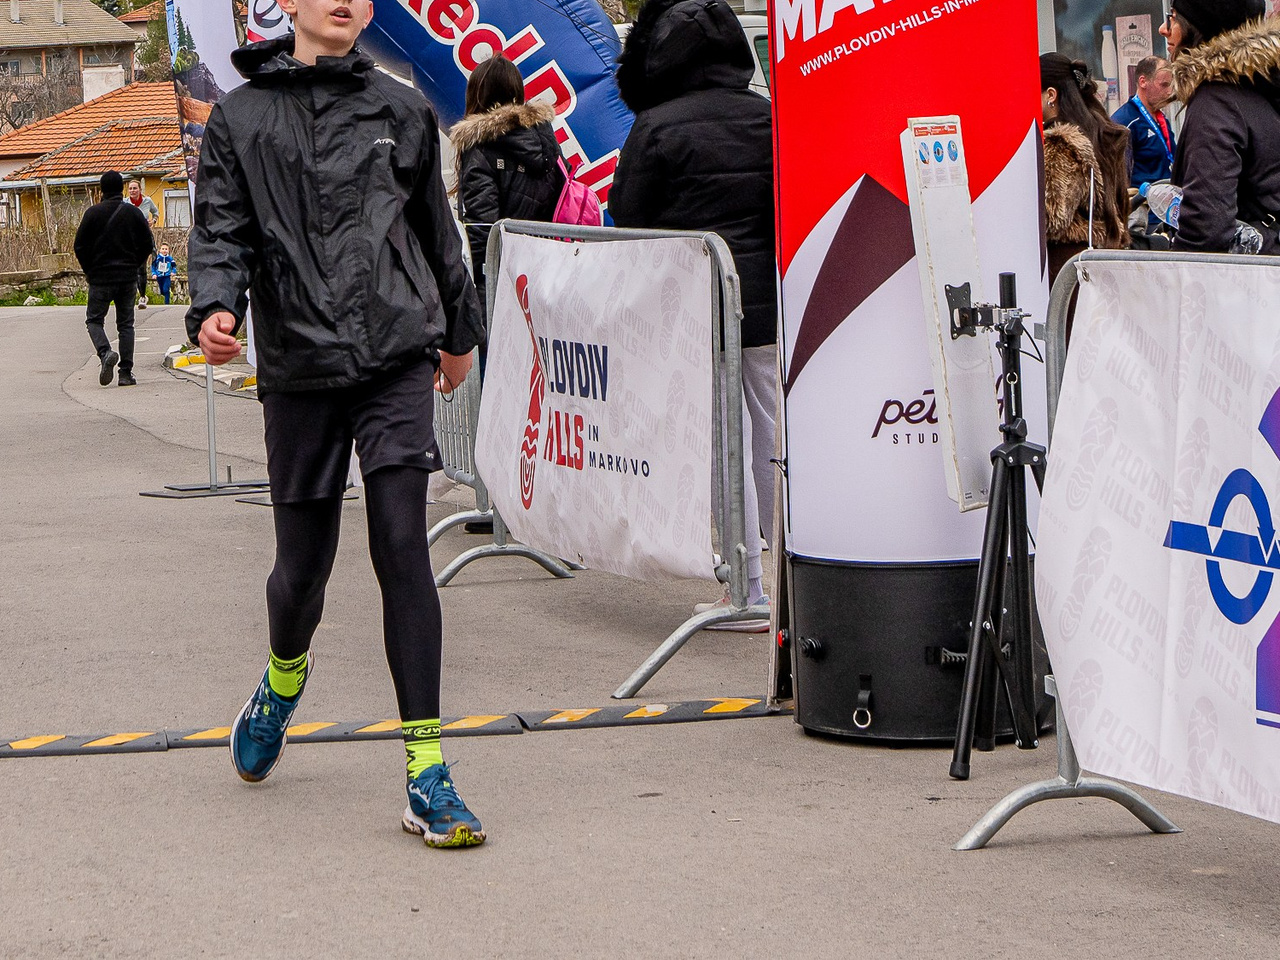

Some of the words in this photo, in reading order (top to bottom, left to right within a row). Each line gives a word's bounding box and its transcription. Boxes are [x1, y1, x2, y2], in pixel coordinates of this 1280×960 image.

[588, 424, 599, 442] IN
[892, 432, 939, 445] STUD
[589, 451, 650, 477] MARKOVO
